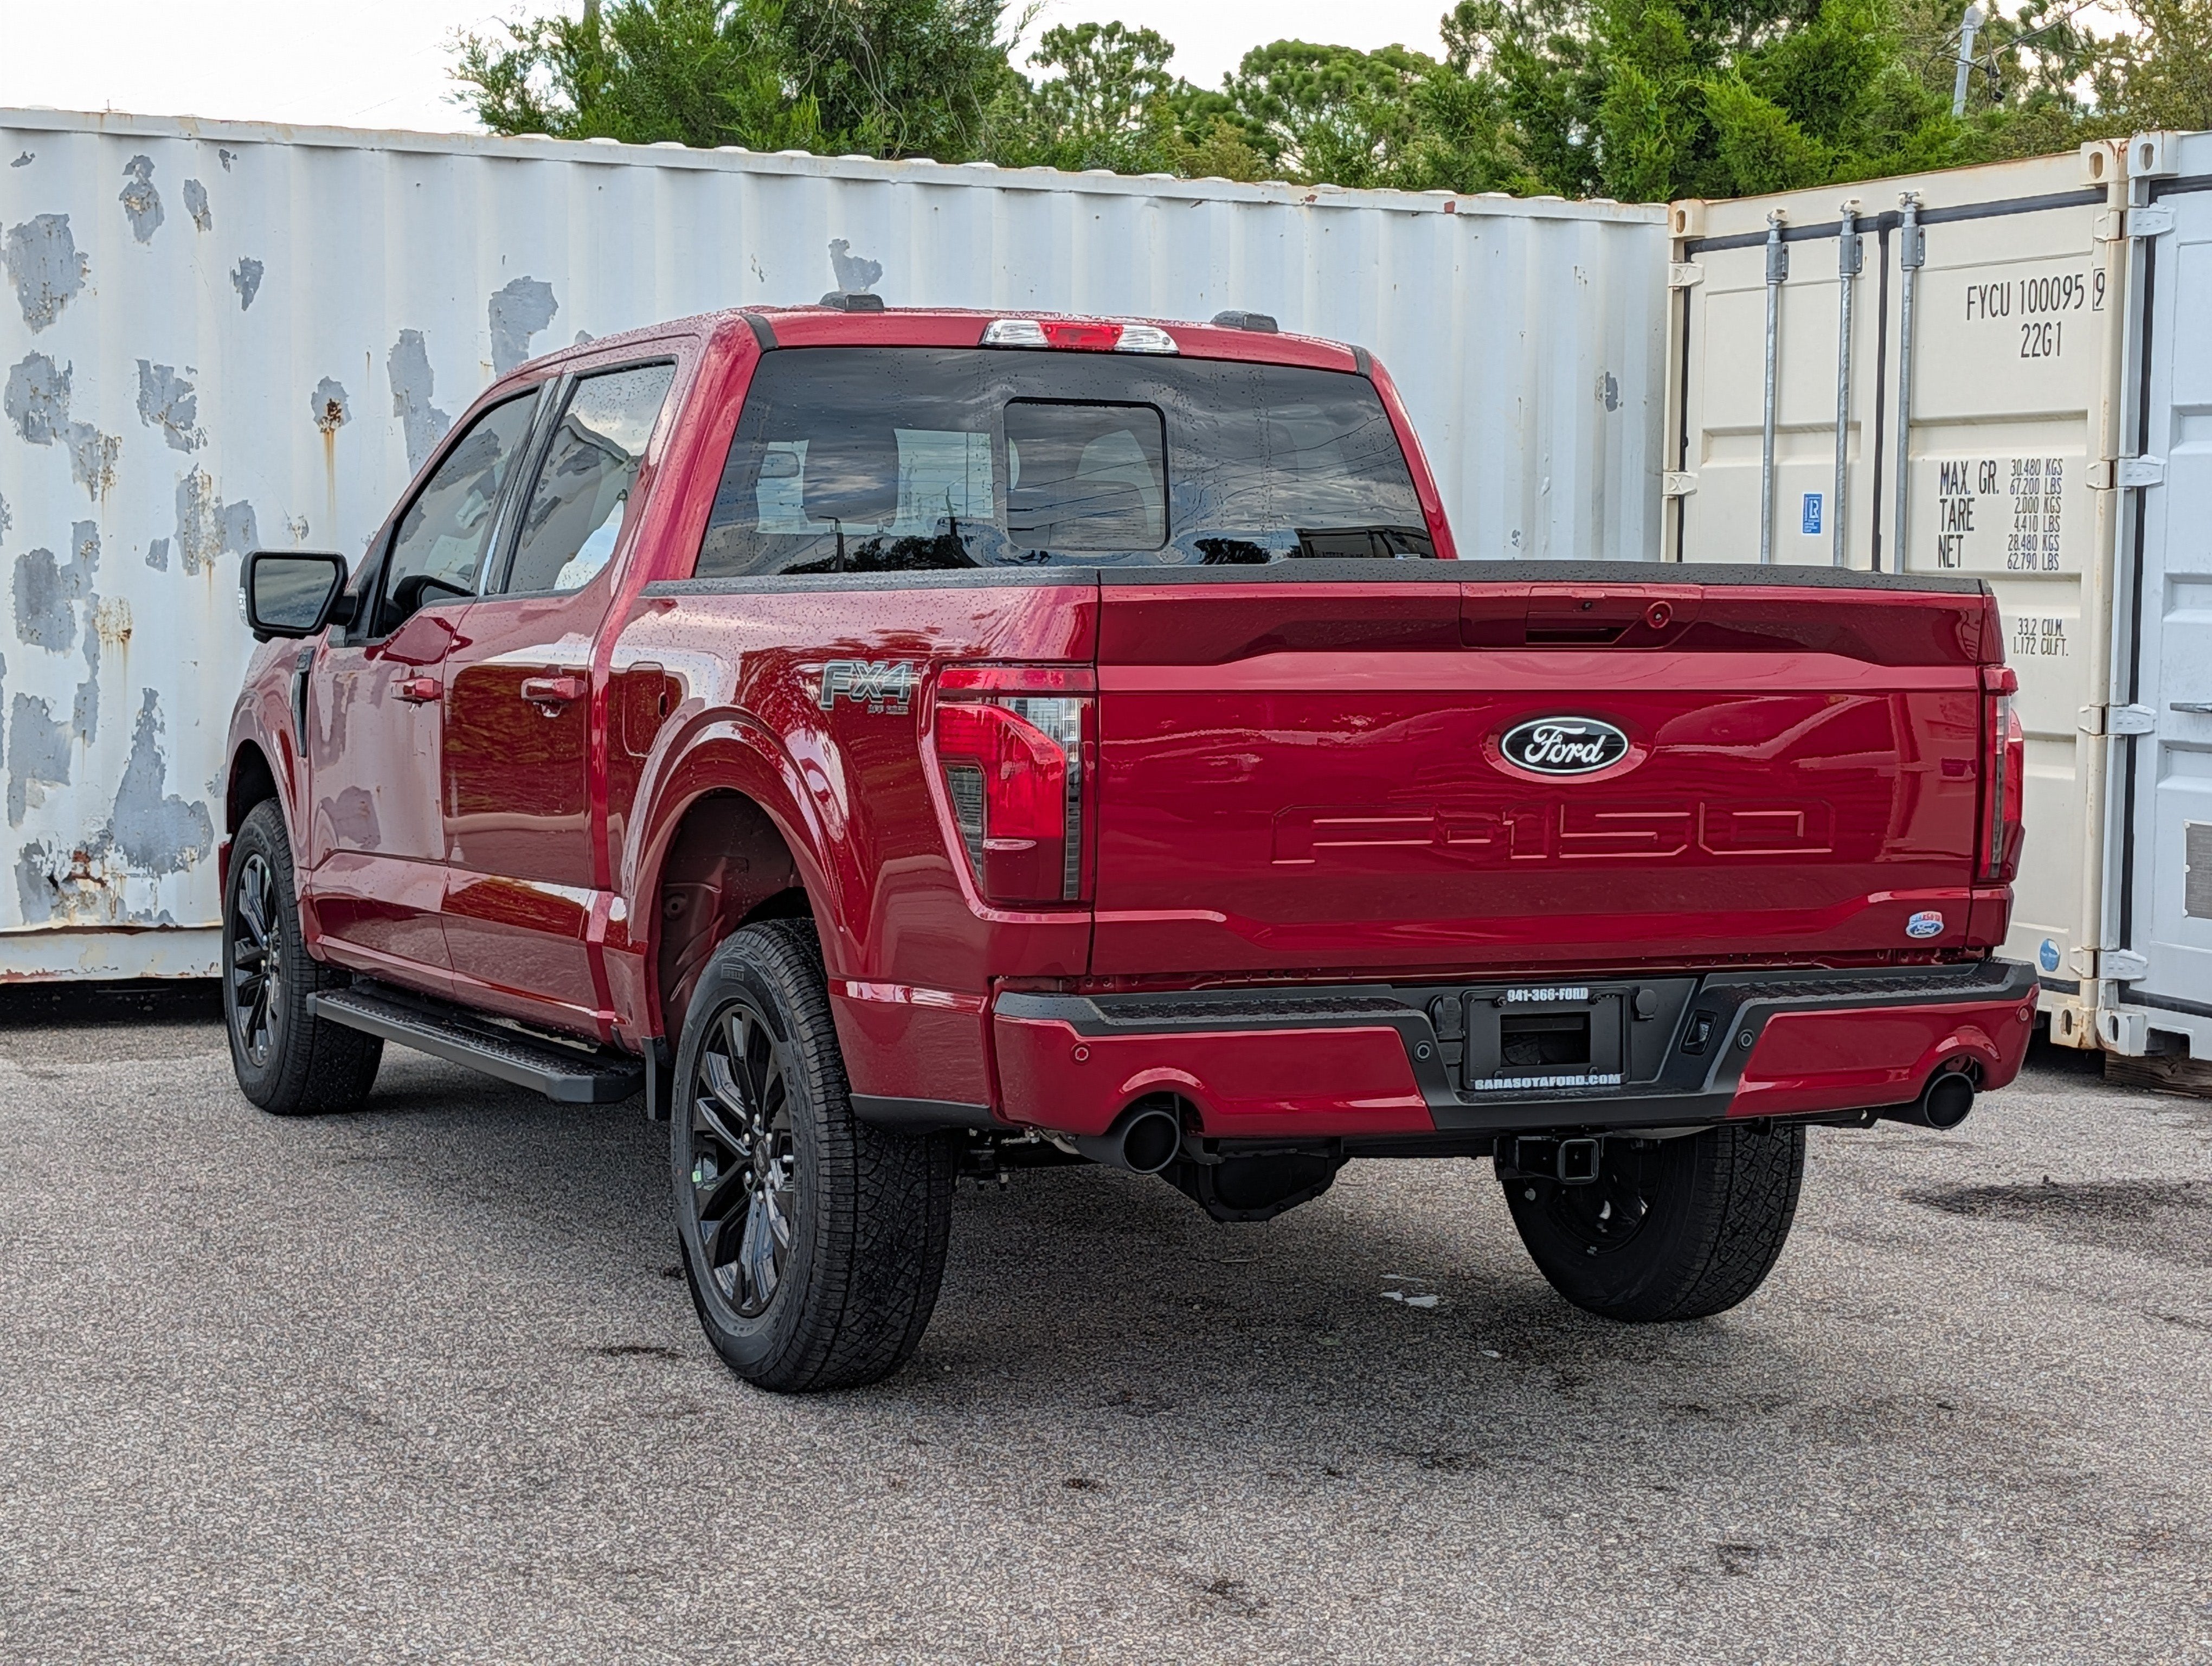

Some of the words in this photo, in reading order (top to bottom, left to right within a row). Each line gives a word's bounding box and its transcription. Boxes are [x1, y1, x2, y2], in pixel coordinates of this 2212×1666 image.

[1966, 281, 2011, 321] FYCU
[2020, 273, 2085, 315] 100095
[2095, 271, 2105, 307] 9
[2020, 321, 2061, 358] 22G1
[1939, 460, 1971, 496] MAX.
[1978, 460, 1999, 495] GR.
[2045, 458, 2063, 476] KGS
[2044, 477, 2062, 495] LBS
[1939, 497, 1975, 532] TARE
[2043, 496, 2062, 514] KGS
[2042, 515, 2061, 533] LBS
[1938, 534, 1964, 568] NET
[2042, 534, 2060, 552] KGS
[2042, 552, 2060, 571] LBS
[820, 659, 921, 710] FX4
[1524, 725, 1606, 764] Ford
[1474, 1073, 1622, 1090] SARASOTAFORD.COM
